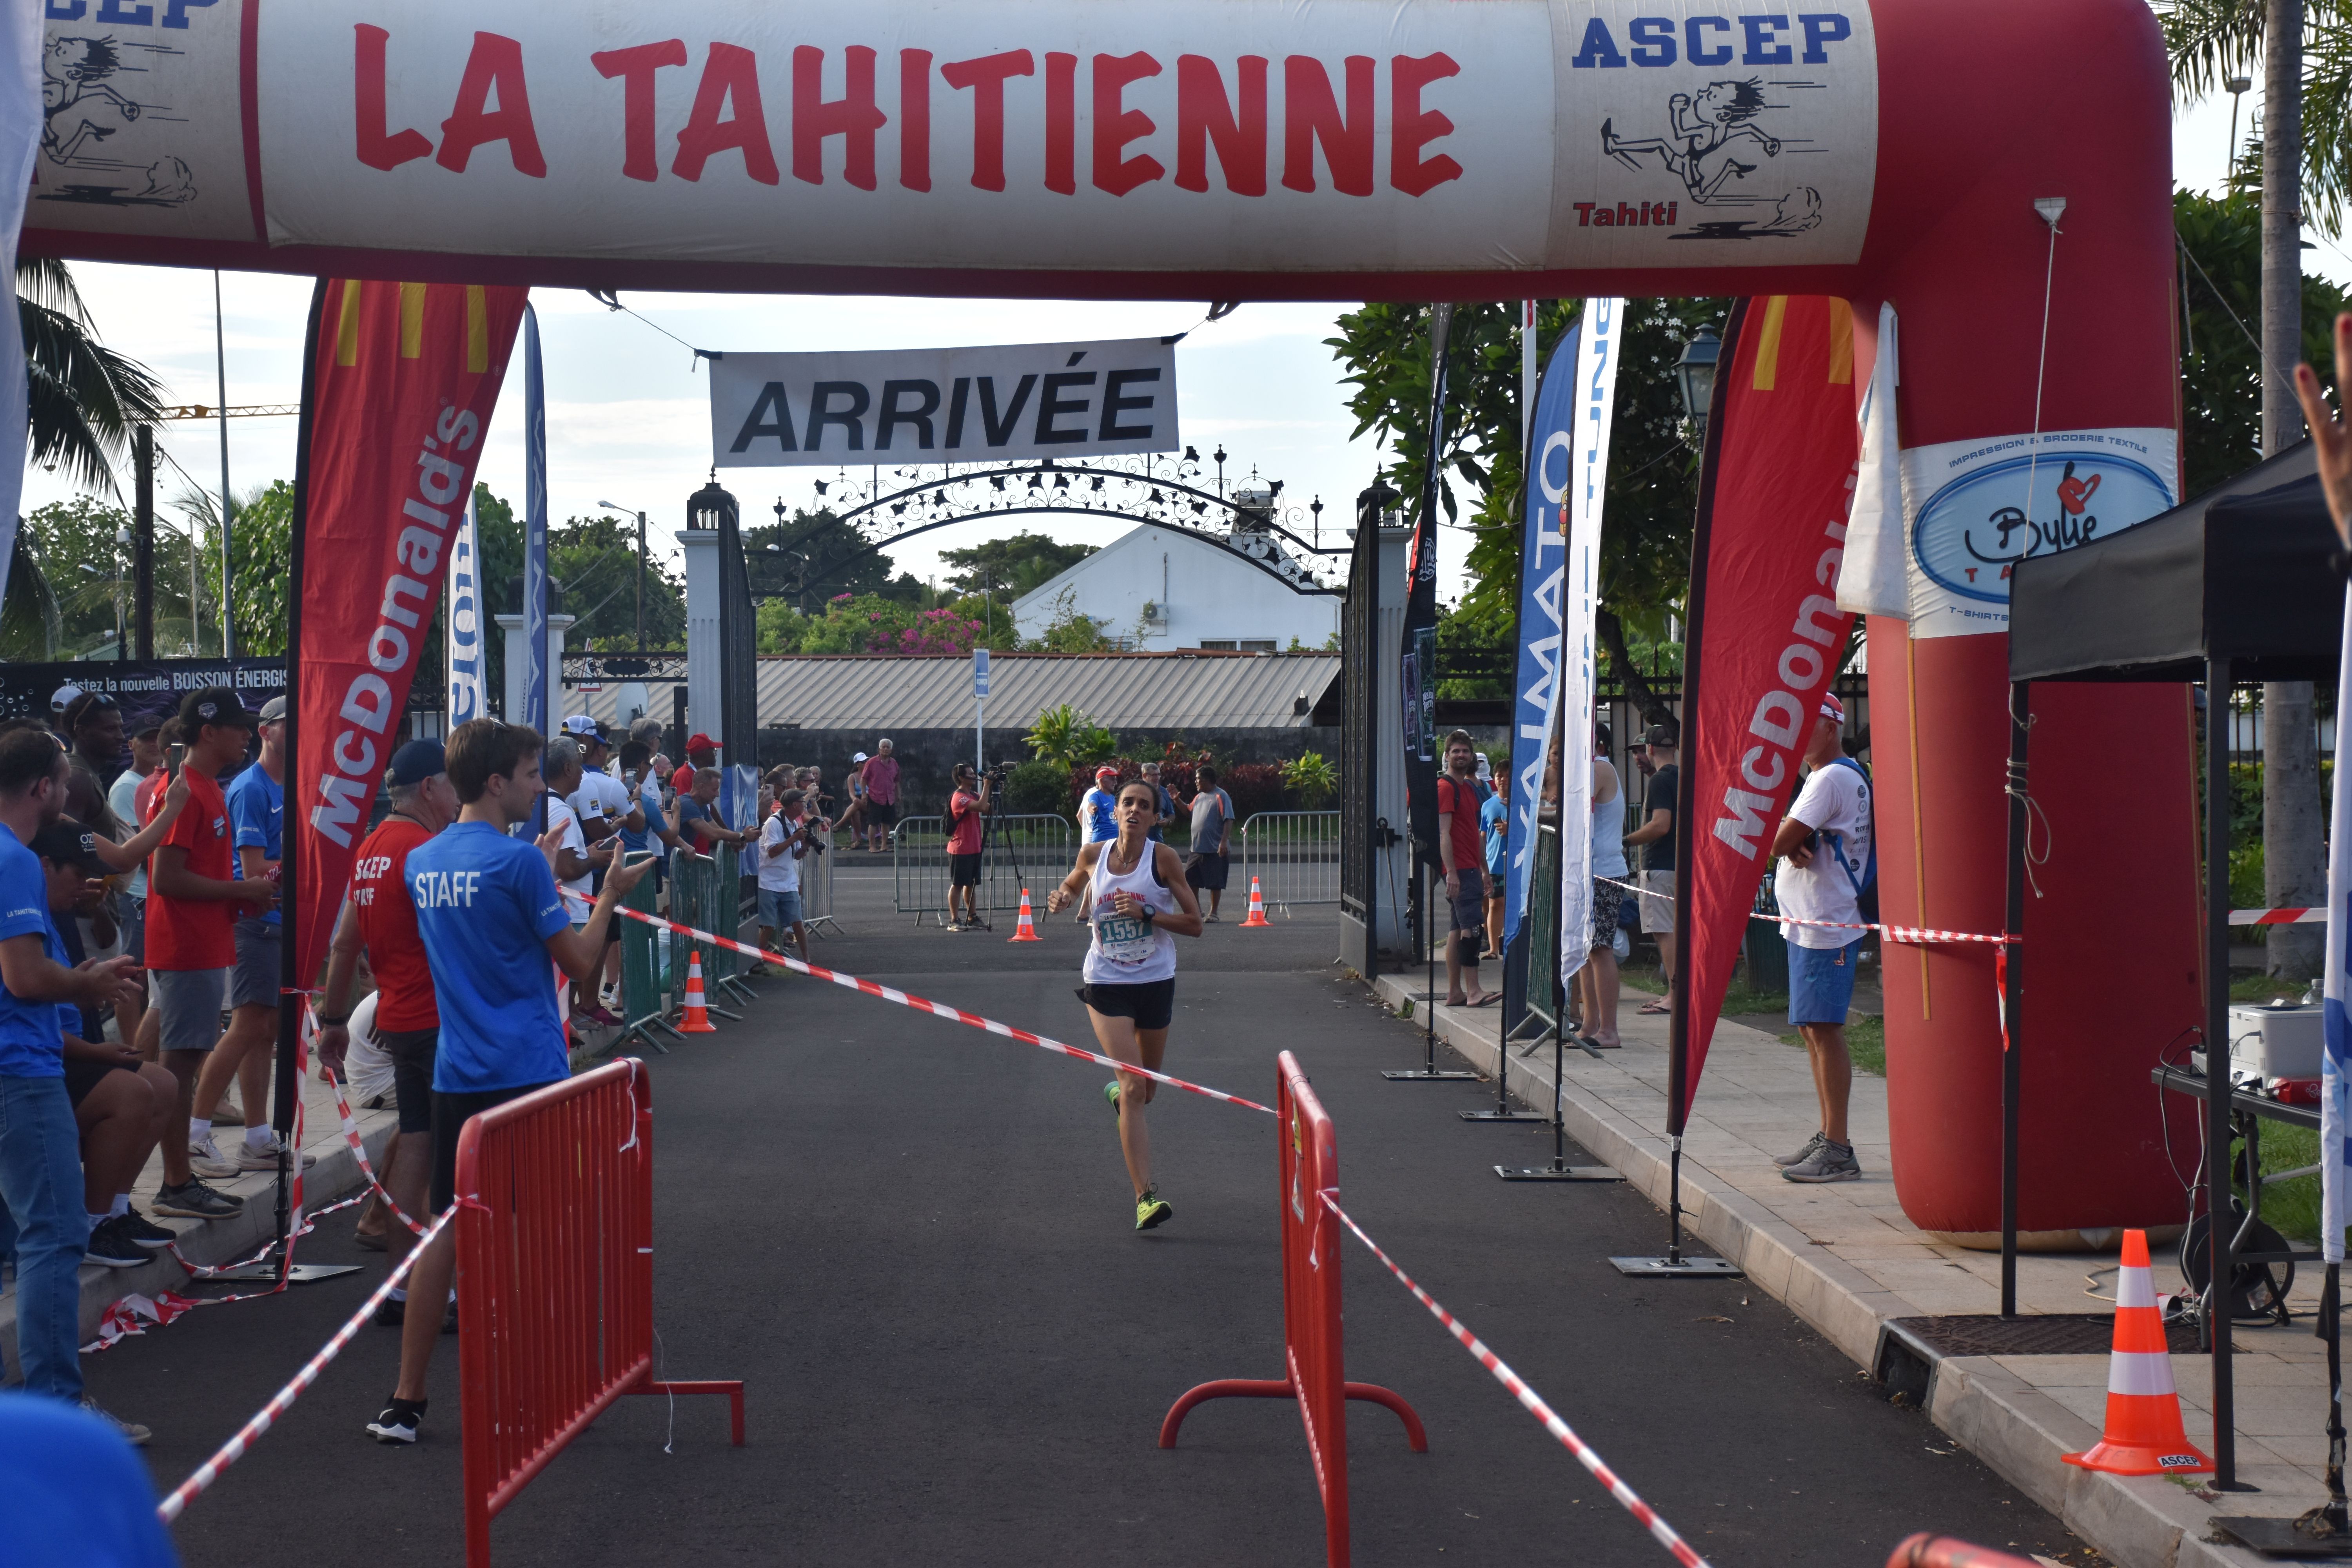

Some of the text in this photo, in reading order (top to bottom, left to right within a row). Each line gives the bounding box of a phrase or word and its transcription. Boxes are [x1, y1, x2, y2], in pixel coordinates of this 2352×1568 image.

[1572, 13, 1851, 68] ASCEP
[354, 23, 1463, 198] LA TAHITIENNE
[1573, 201, 1678, 227] Tahiti
[729, 351, 1161, 453] ARRIVÉE
[1949, 439, 2024, 468] IMPRESSION
[2044, 434, 2104, 443] BRODERIE
[2109, 437, 2147, 454] TEXTILE
[310, 404, 478, 849] McDonald's
[1949, 606, 2009, 622] T-SHIRTS
[1712, 459, 1859, 861] McDona
[64, 678, 103, 692] Testez
[107, 677, 117, 691] la
[120, 676, 170, 691] nouvelle
[174, 671, 231, 690] BOISSON
[416, 871, 481, 908] STAFF
[1096, 897, 1103, 907] LA
[1104, 920, 1144, 941] 1557
[2161, 1455, 2198, 1466] ASCEP
